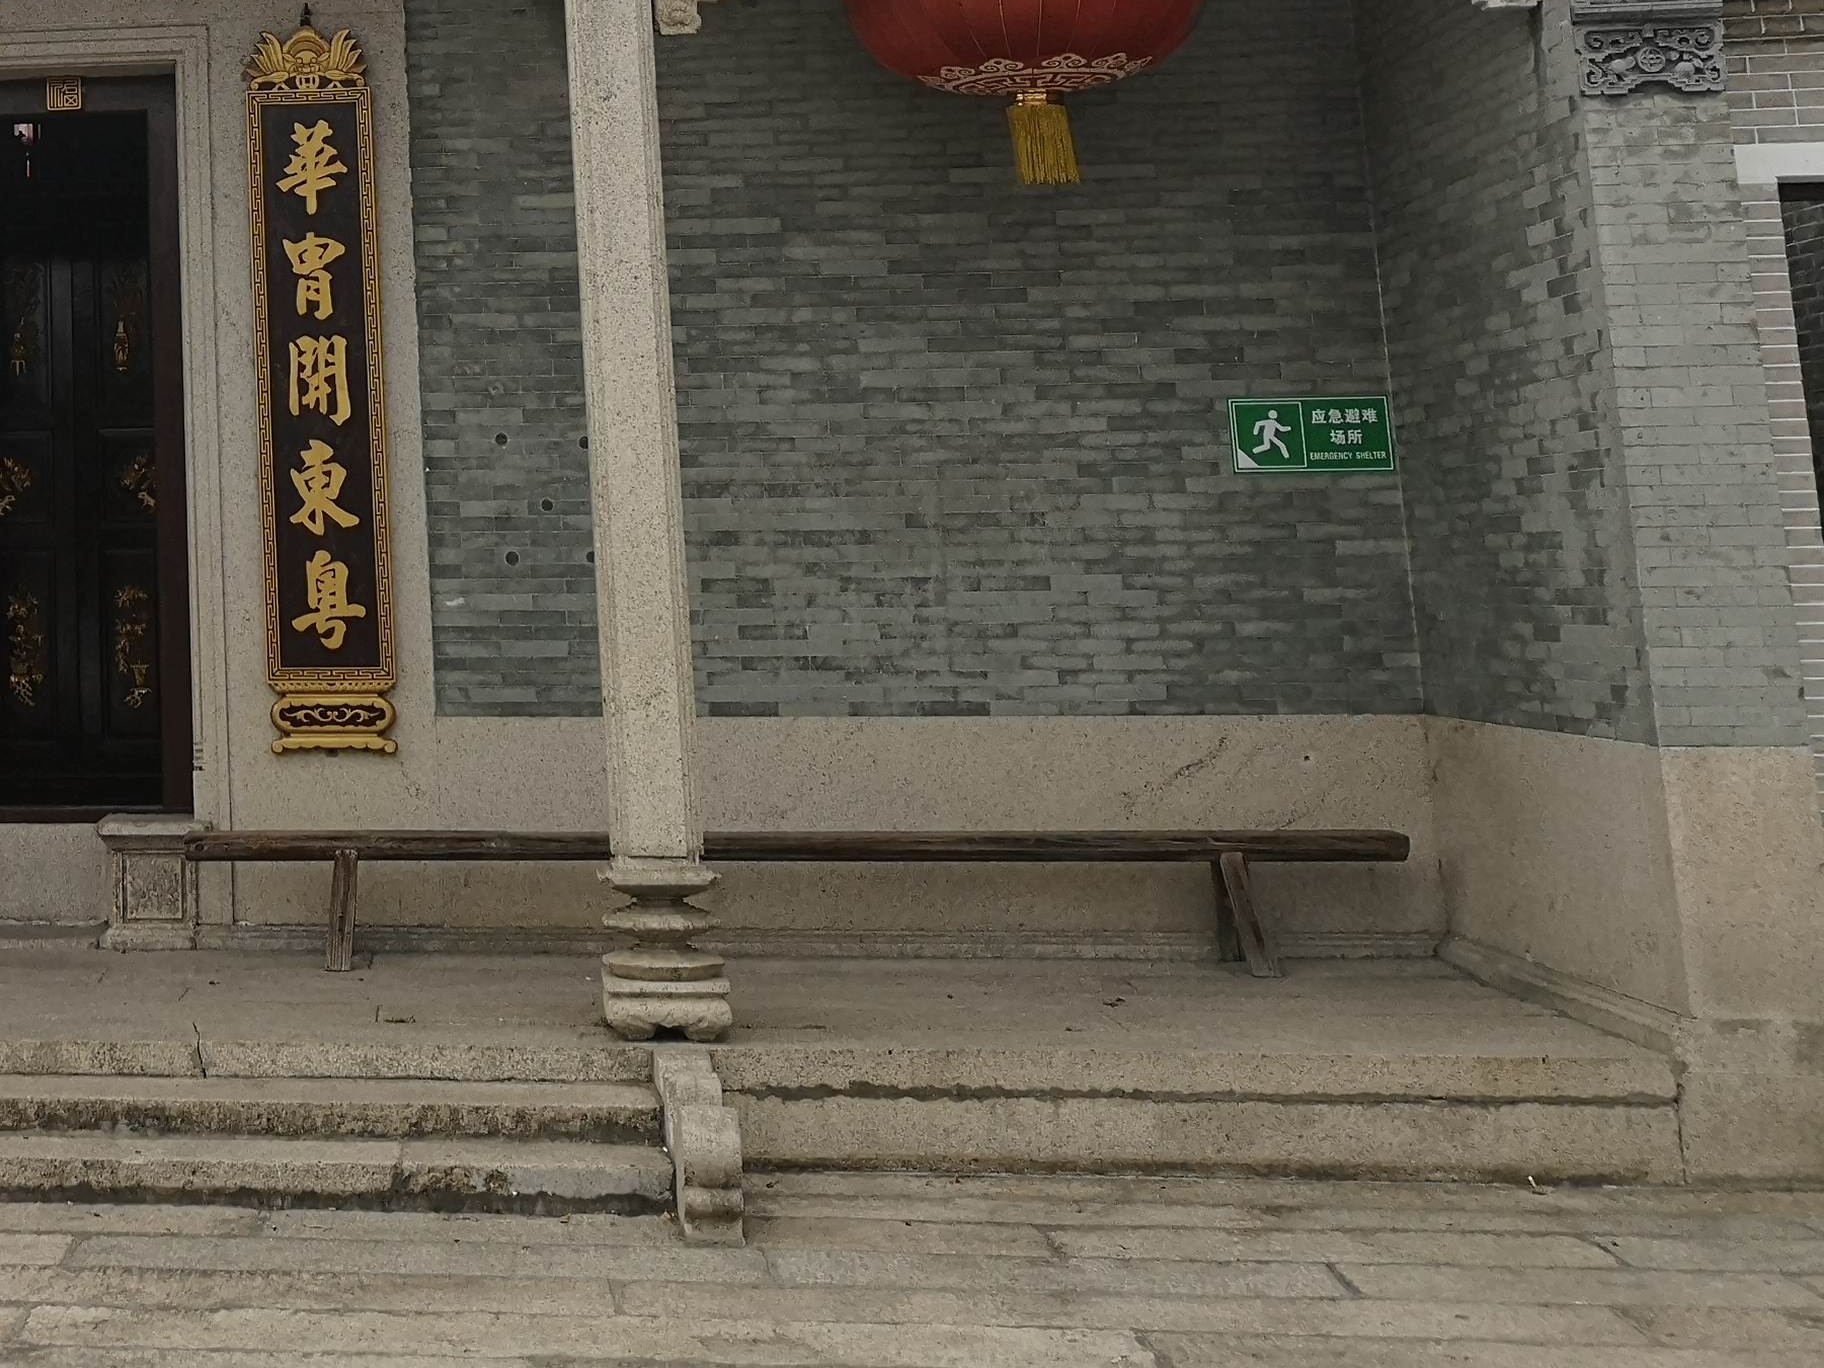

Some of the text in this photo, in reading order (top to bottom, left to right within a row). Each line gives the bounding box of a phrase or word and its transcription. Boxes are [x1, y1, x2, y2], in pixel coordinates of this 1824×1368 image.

[1311, 408, 1378, 424] 应急避难
[1329, 429, 1362, 444] 场所
[1310, 450, 1387, 461] EMERGENCY SHELTER
